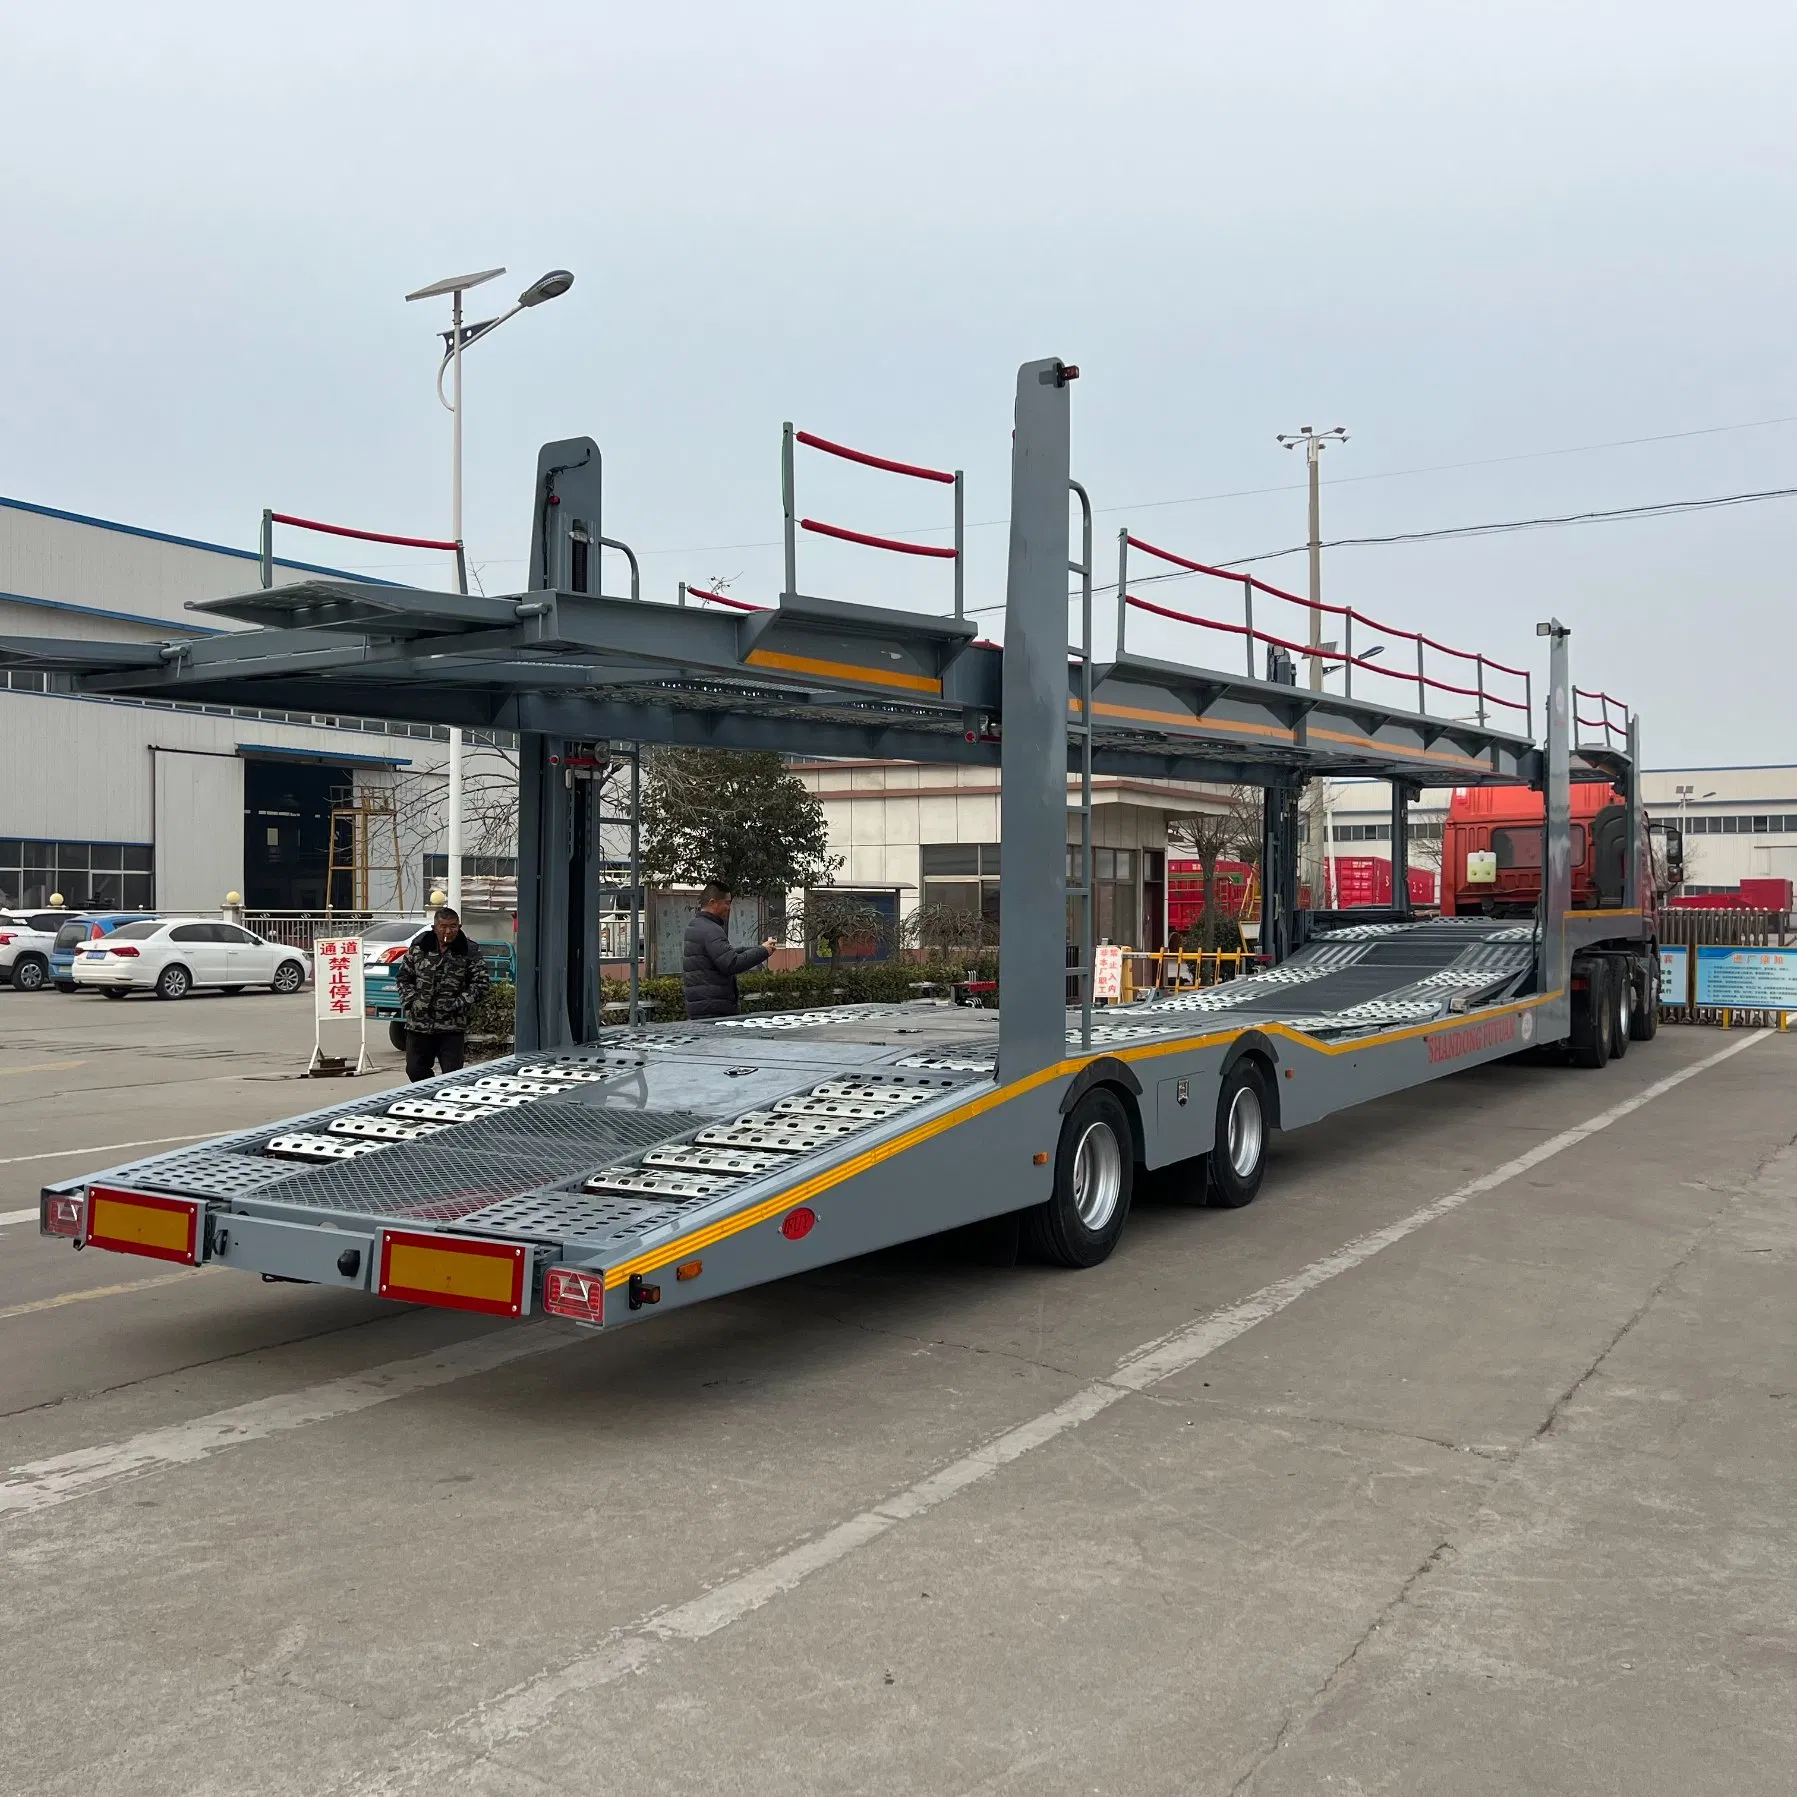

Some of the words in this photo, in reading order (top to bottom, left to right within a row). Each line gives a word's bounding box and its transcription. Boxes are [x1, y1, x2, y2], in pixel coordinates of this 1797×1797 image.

[319, 941, 358, 956] 通道
[328, 957, 352, 1014] 禁止停车
[1108, 949, 1118, 993] 禁止入内
[1427, 1028, 1481, 1063] SHANDONG
